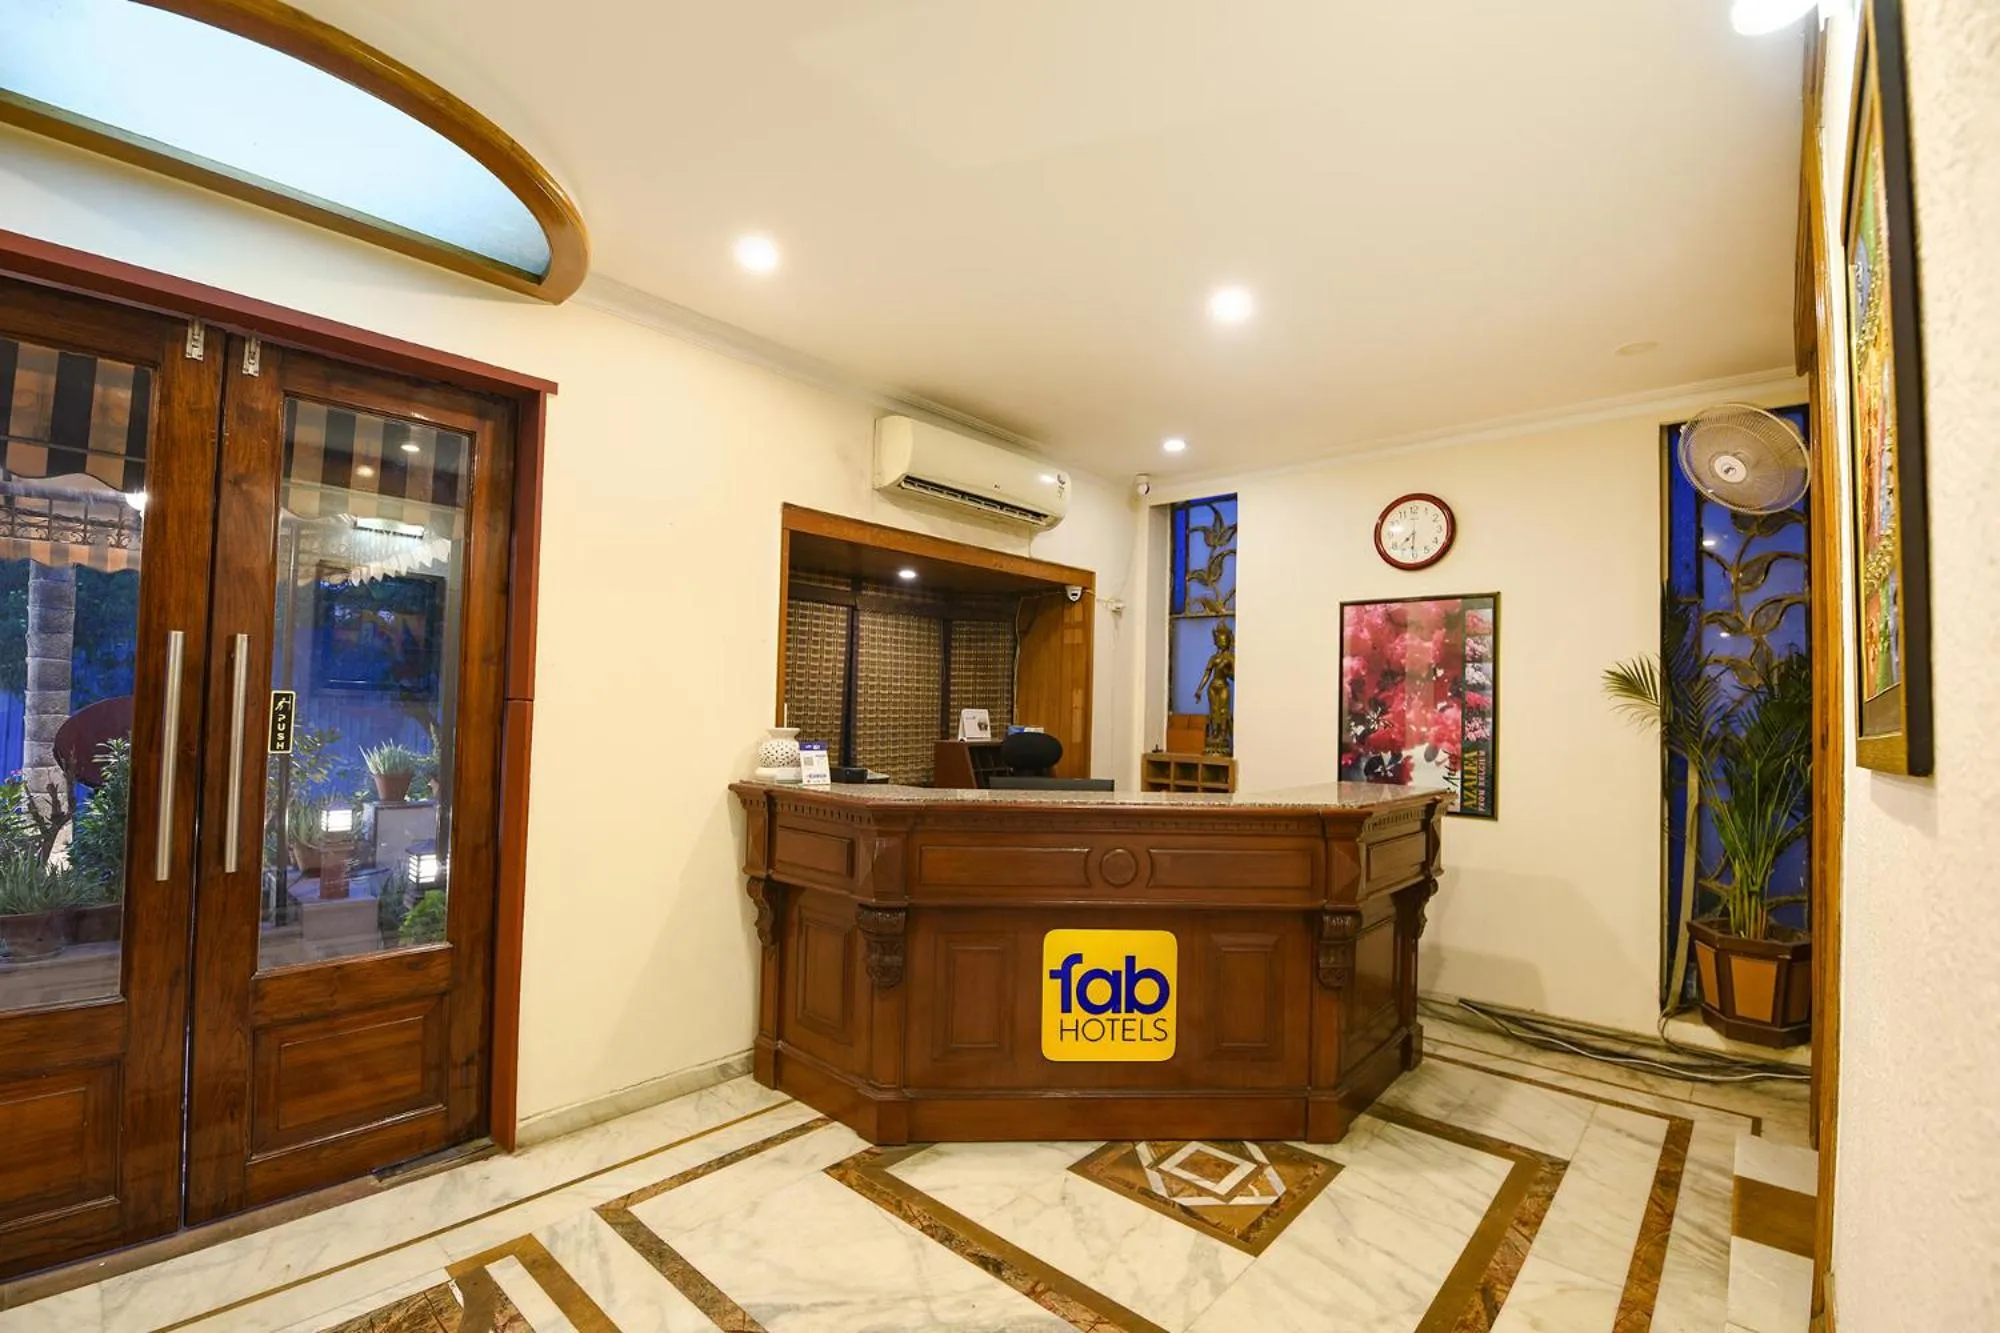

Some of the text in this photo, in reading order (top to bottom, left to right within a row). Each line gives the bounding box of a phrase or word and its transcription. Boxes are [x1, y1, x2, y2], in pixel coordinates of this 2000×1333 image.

[1399, 511, 1407, 519] 11
[1409, 505, 1419, 514] 12
[1432, 513, 1439, 522] 2
[1432, 537, 1438, 545] 4
[1423, 546, 1430, 555] 5
[276, 714, 286, 750] PUSH
[1463, 749, 1478, 810] AZALEA
[1478, 749, 1486, 812] FROM BELGIUM
[1049, 953, 1170, 1015] fab
[1060, 1018, 1168, 1042] HOTELS
